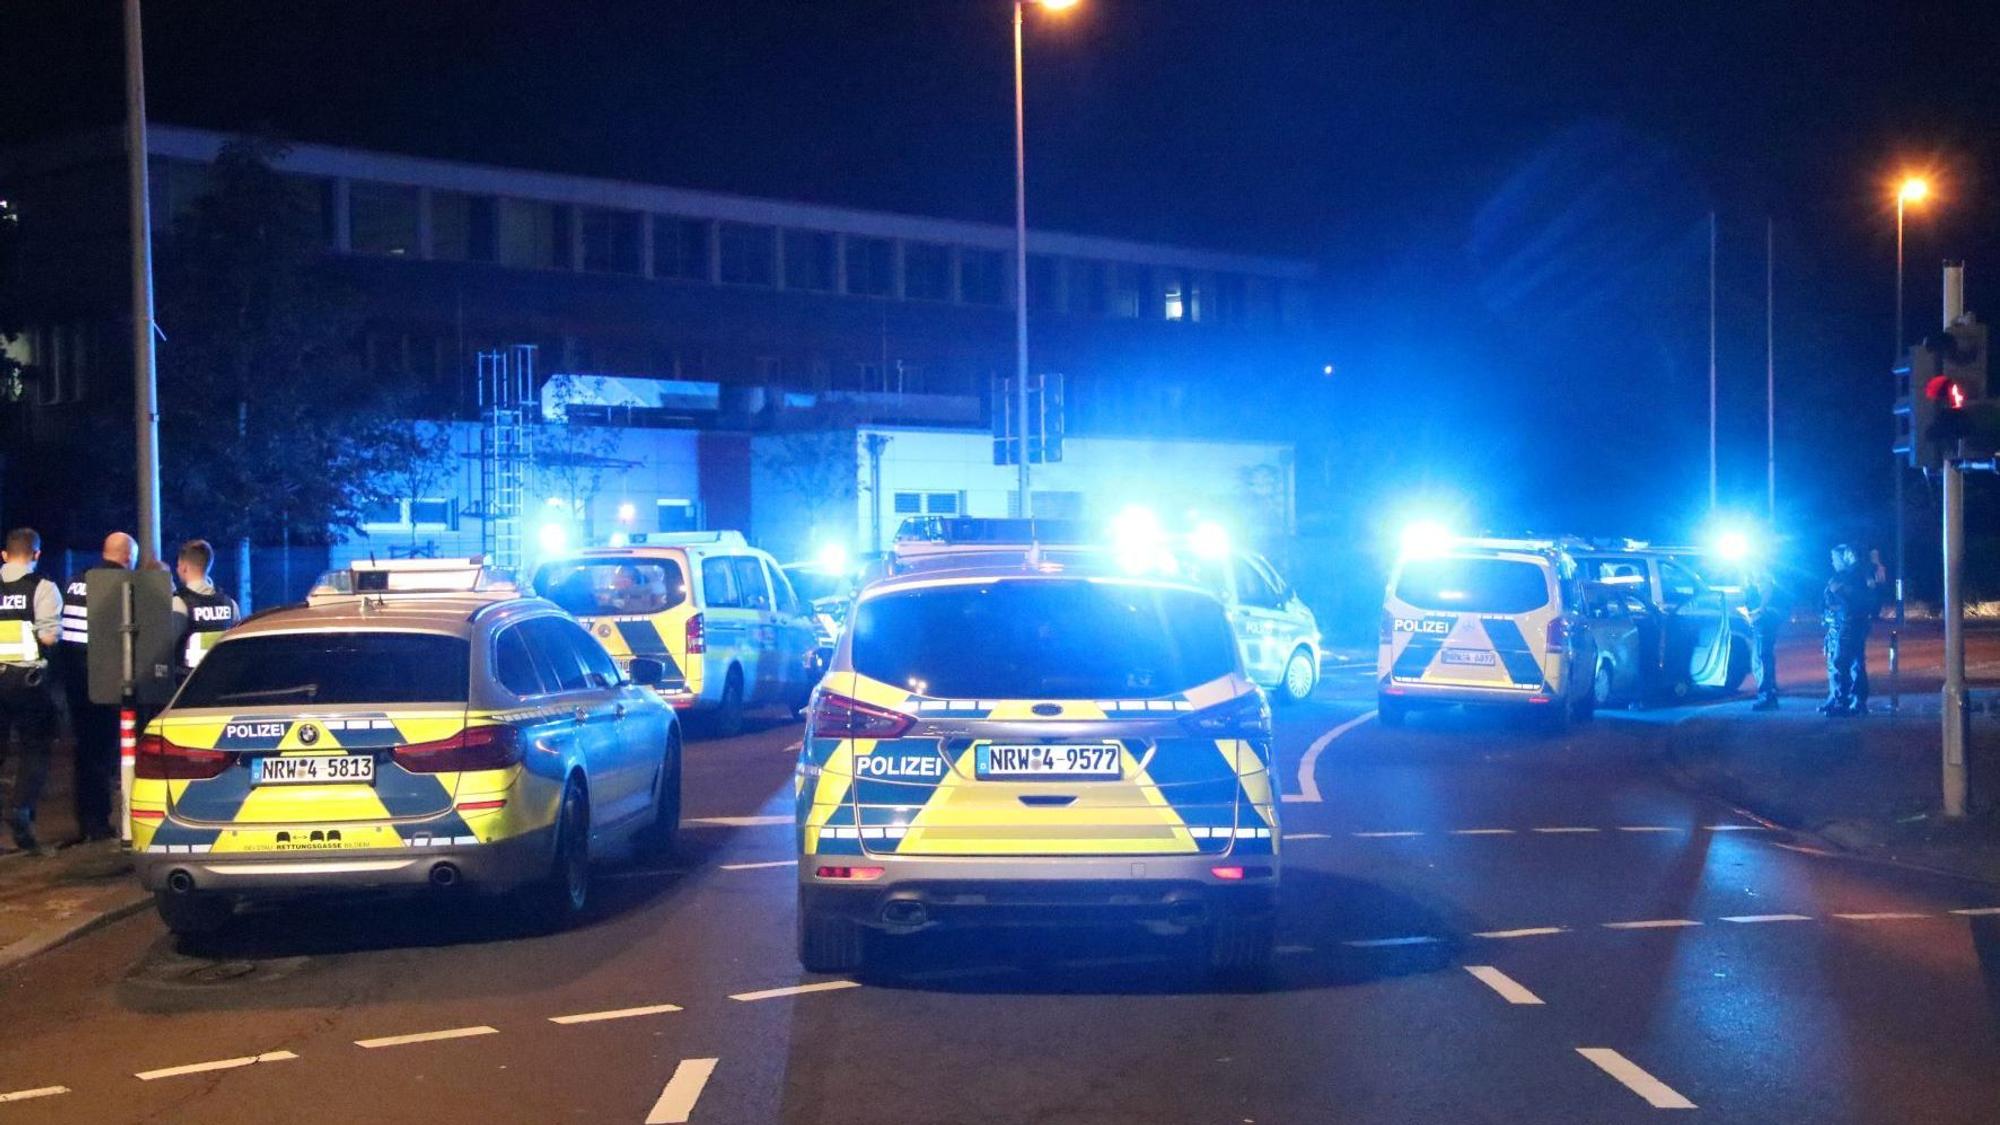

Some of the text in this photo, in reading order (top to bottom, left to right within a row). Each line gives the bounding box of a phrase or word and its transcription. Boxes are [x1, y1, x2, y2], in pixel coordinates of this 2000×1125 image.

[1393, 618, 1449, 634] POLIZEI
[226, 723, 286, 738] POLIZEI
[262, 759, 298, 780] NRW
[327, 757, 373, 778] 5813
[856, 755, 942, 777] POLIZEI
[989, 748, 1030, 771] NRW
[276, 842, 342, 850] RETTUNGSGASSE
